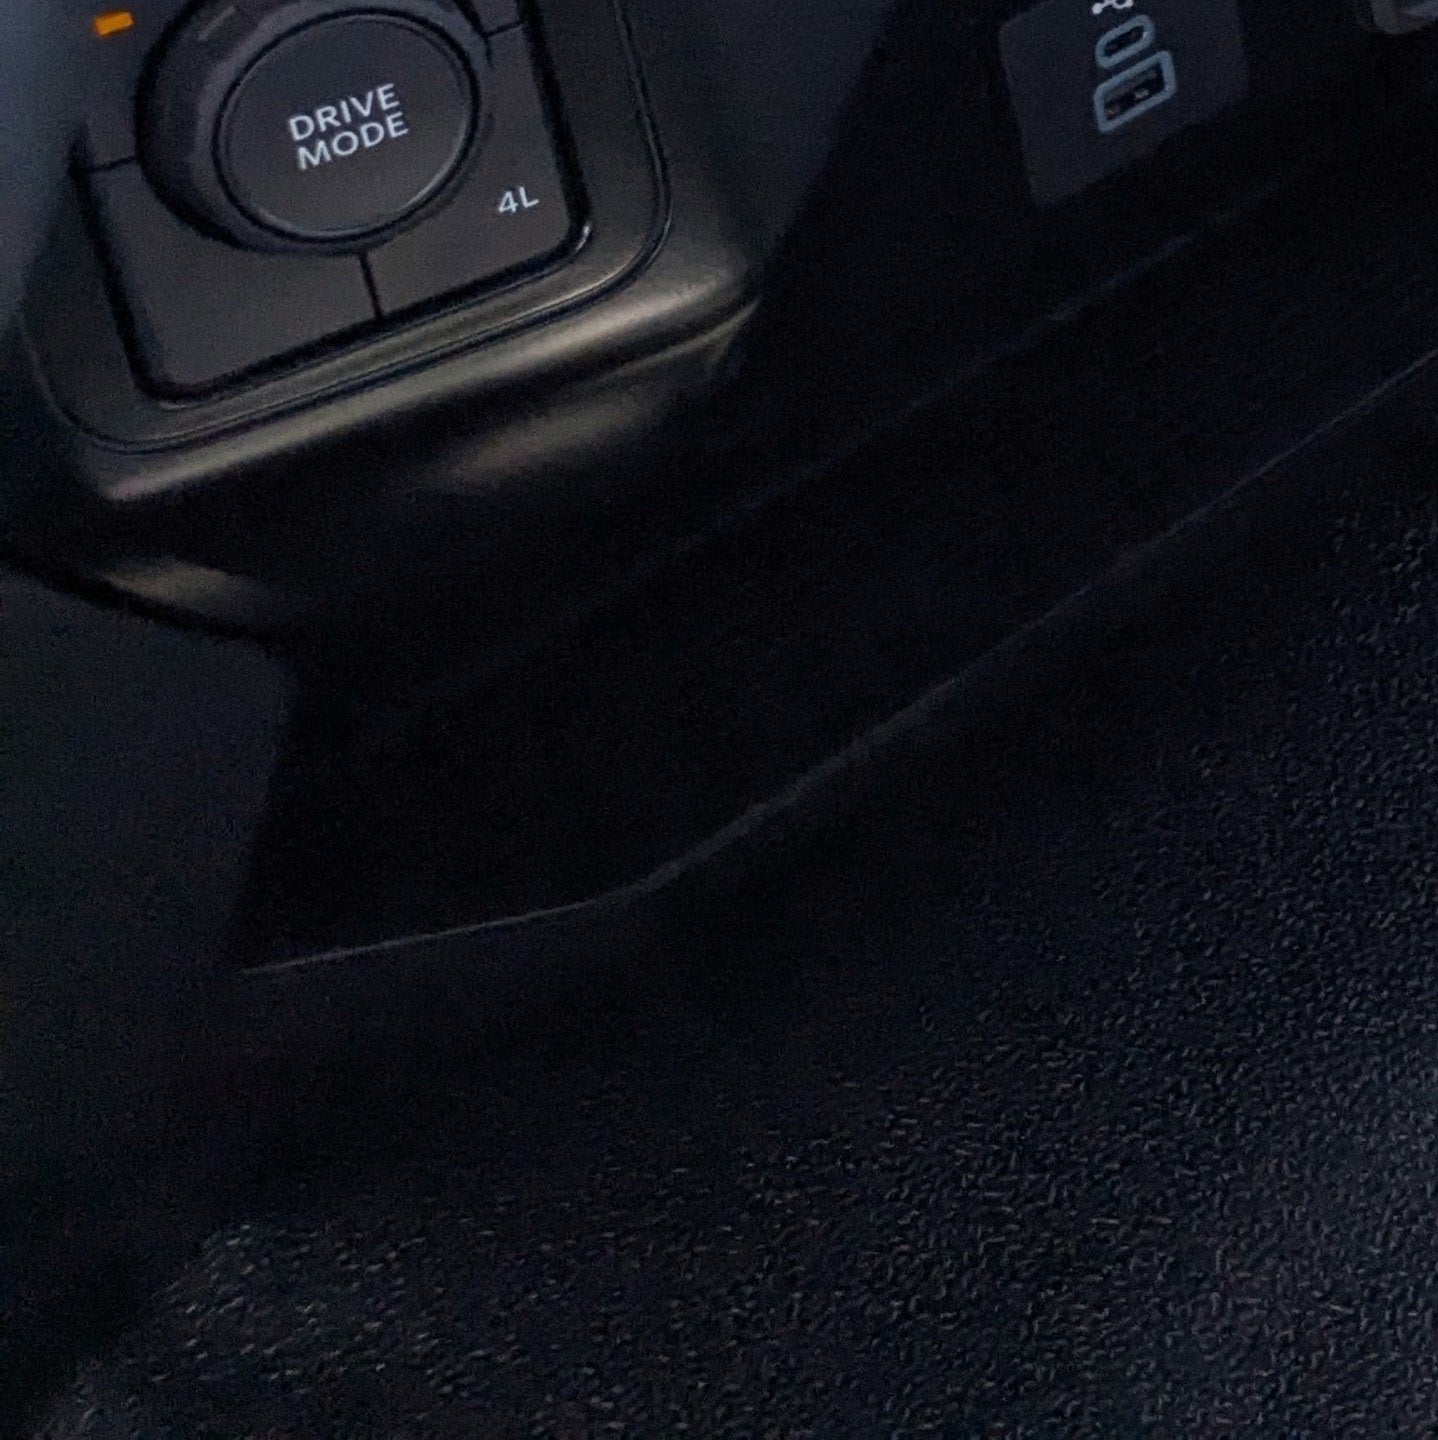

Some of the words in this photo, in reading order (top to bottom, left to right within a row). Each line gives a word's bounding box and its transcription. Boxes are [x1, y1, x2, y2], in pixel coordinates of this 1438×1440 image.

[287, 82, 402, 142] DRIVE
[296, 110, 410, 171] MODE
[497, 185, 540, 216] 4L
